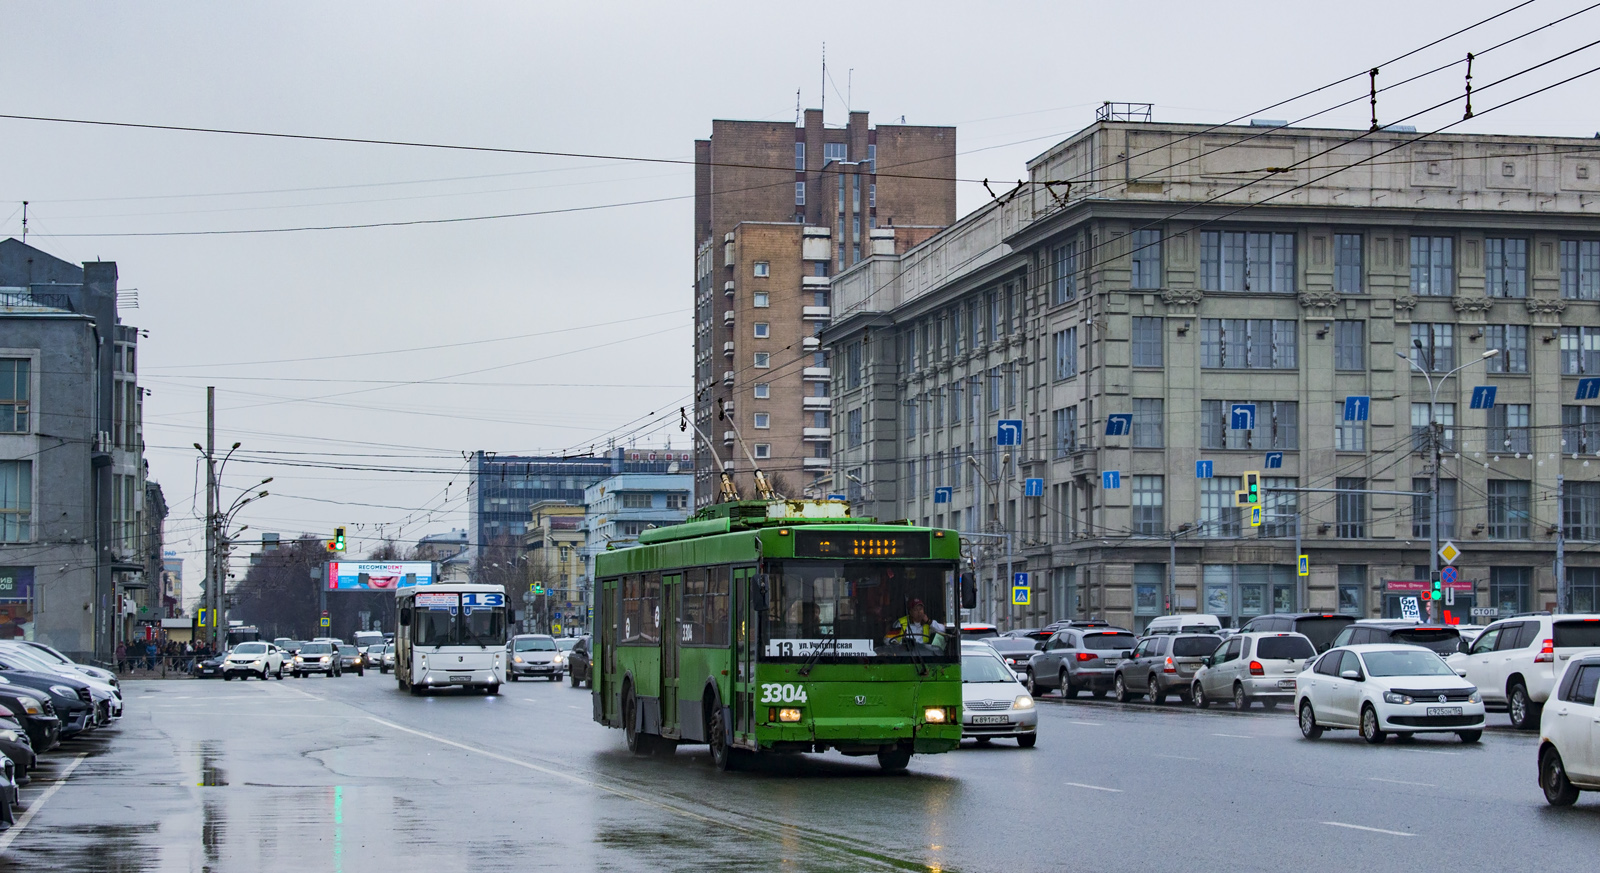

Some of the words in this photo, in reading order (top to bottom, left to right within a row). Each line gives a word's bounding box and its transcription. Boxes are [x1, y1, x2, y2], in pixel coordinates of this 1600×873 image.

[462, 594, 504, 606] 13
[1401, 596, 1415, 605] би
[682, 623, 693, 642] 3304
[776, 641, 793, 656] 13
[760, 683, 807, 703] 3304
